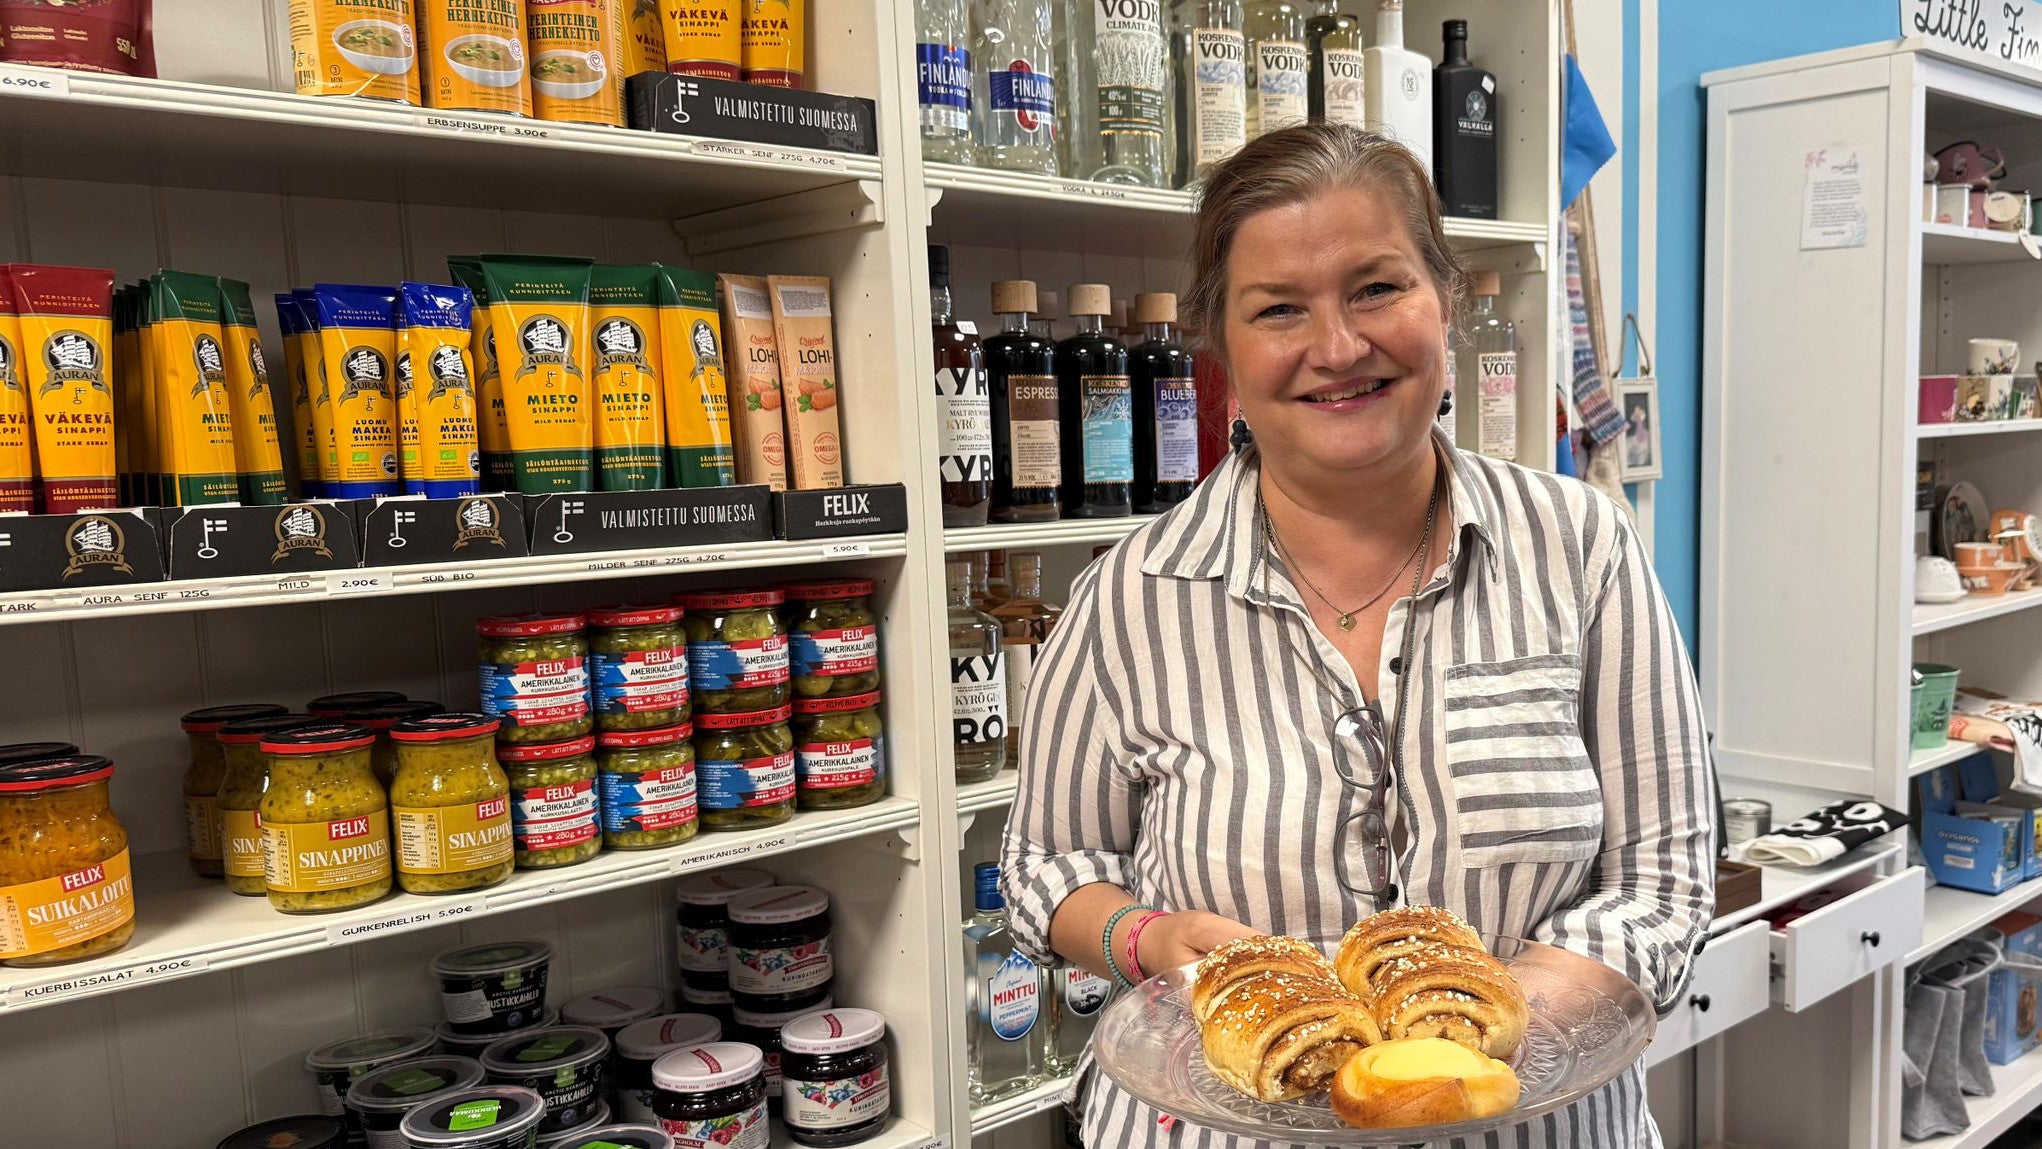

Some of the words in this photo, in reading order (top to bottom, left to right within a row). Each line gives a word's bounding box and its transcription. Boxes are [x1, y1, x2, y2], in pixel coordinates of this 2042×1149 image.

[670, 8, 729, 21] VÄKEVÄ
[1100, 0, 1161, 20] VODK
[447, 9, 519, 30] HERNEKEITTO
[530, 14, 597, 28] PERINTEINEN
[741, 19, 789, 30] ÄKEVÄ
[1106, 20, 1147, 31] CLIMATE
[1914, 0, 1988, 51] Little
[530, 27, 600, 42] HERNEKEITTO
[1199, 43, 1244, 61] VODK
[1262, 55, 1306, 72] VODK
[3, 76, 51, 89] 6.90€
[714, 97, 795, 125] VALMISTETTU
[799, 108, 858, 132] SUOMESSA
[427, 117, 506, 133] ERBSENSUPPE
[514, 128, 548, 138] 3.90€
[1458, 120, 1493, 131] VALHALLA
[703, 144, 746, 156] STARKER
[780, 152, 803, 162] 275G
[809, 156, 836, 166] 4.70€
[1062, 184, 1086, 194] VODKA
[39, 294, 92, 302] PERINTEITÄ
[509, 288, 571, 296] KUNNIOITTAEN
[33, 300, 101, 308] KUNNIOITTAEN
[527, 353, 570, 365] AURAN
[602, 353, 643, 365] AURAN
[799, 348, 833, 364] LOHI-
[53, 370, 99, 382] AURAN
[350, 381, 386, 390] AURAN
[438, 381, 467, 389] AURA
[527, 394, 578, 405] MIETO
[602, 392, 651, 403] MIETO
[1015, 386, 1059, 400] ESPRESS
[606, 404, 650, 412] SINAPPI
[949, 409, 966, 417] MALT
[44, 411, 112, 425] VÄKEVÄ
[56, 426, 107, 434] SINAPPI
[352, 426, 391, 434] MAKEA
[440, 425, 475, 433] MAKEA
[822, 493, 868, 516] FELIX
[601, 508, 688, 529] VALMISTETTU
[692, 503, 756, 524] SUOMESSA
[815, 518, 843, 527] Herkkuja
[462, 528, 496, 540] AURAN
[282, 538, 322, 549] AURAN
[832, 545, 859, 553] 5.90€
[75, 553, 119, 565] AURAN
[588, 561, 627, 571] MILDER
[665, 555, 690, 566] 275G
[696, 554, 726, 563] 4.70€
[453, 572, 475, 581] BIO
[278, 580, 310, 591] MILD
[341, 578, 379, 589] 2.90€
[83, 595, 123, 606] AURA
[134, 592, 169, 602] SENF
[179, 589, 210, 599] 125G
[0, 602, 37, 613] TARK
[842, 629, 864, 641] FELIX
[762, 637, 782, 651] FELIX
[645, 649, 672, 663] FELIX
[745, 653, 789, 665] AMERIKKALAINE
[536, 661, 566, 676] FELIX
[630, 662, 684, 676] AMERIKKALAINEN
[521, 674, 580, 689] AMERIKKALAINEN
[955, 692, 985, 706] KYRÖ
[826, 743, 852, 756] FELIX
[773, 754, 790, 769] FELIX
[808, 754, 869, 767] AMERIKKALAINEN
[661, 766, 685, 781] FELIX
[546, 785, 575, 800] FELIX
[646, 778, 694, 794] AMERIKKALAINEN
[478, 799, 505, 819] FELIX
[530, 797, 589, 813] AMERIKKALAINEN
[331, 818, 367, 838] FELIX
[555, 831, 575, 840] 280g
[681, 846, 751, 866] AMERIKANISCH
[756, 838, 785, 850] 4.90€
[63, 865, 103, 890] FELIX
[341, 912, 431, 937] GURKENRELISH
[438, 905, 474, 918] 5.90€
[25, 970, 135, 998] KUERBISSALAT
[145, 960, 192, 975] 4.90€
[993, 982, 1036, 1006] MINTTU
[1080, 984, 1098, 995] BLACK
